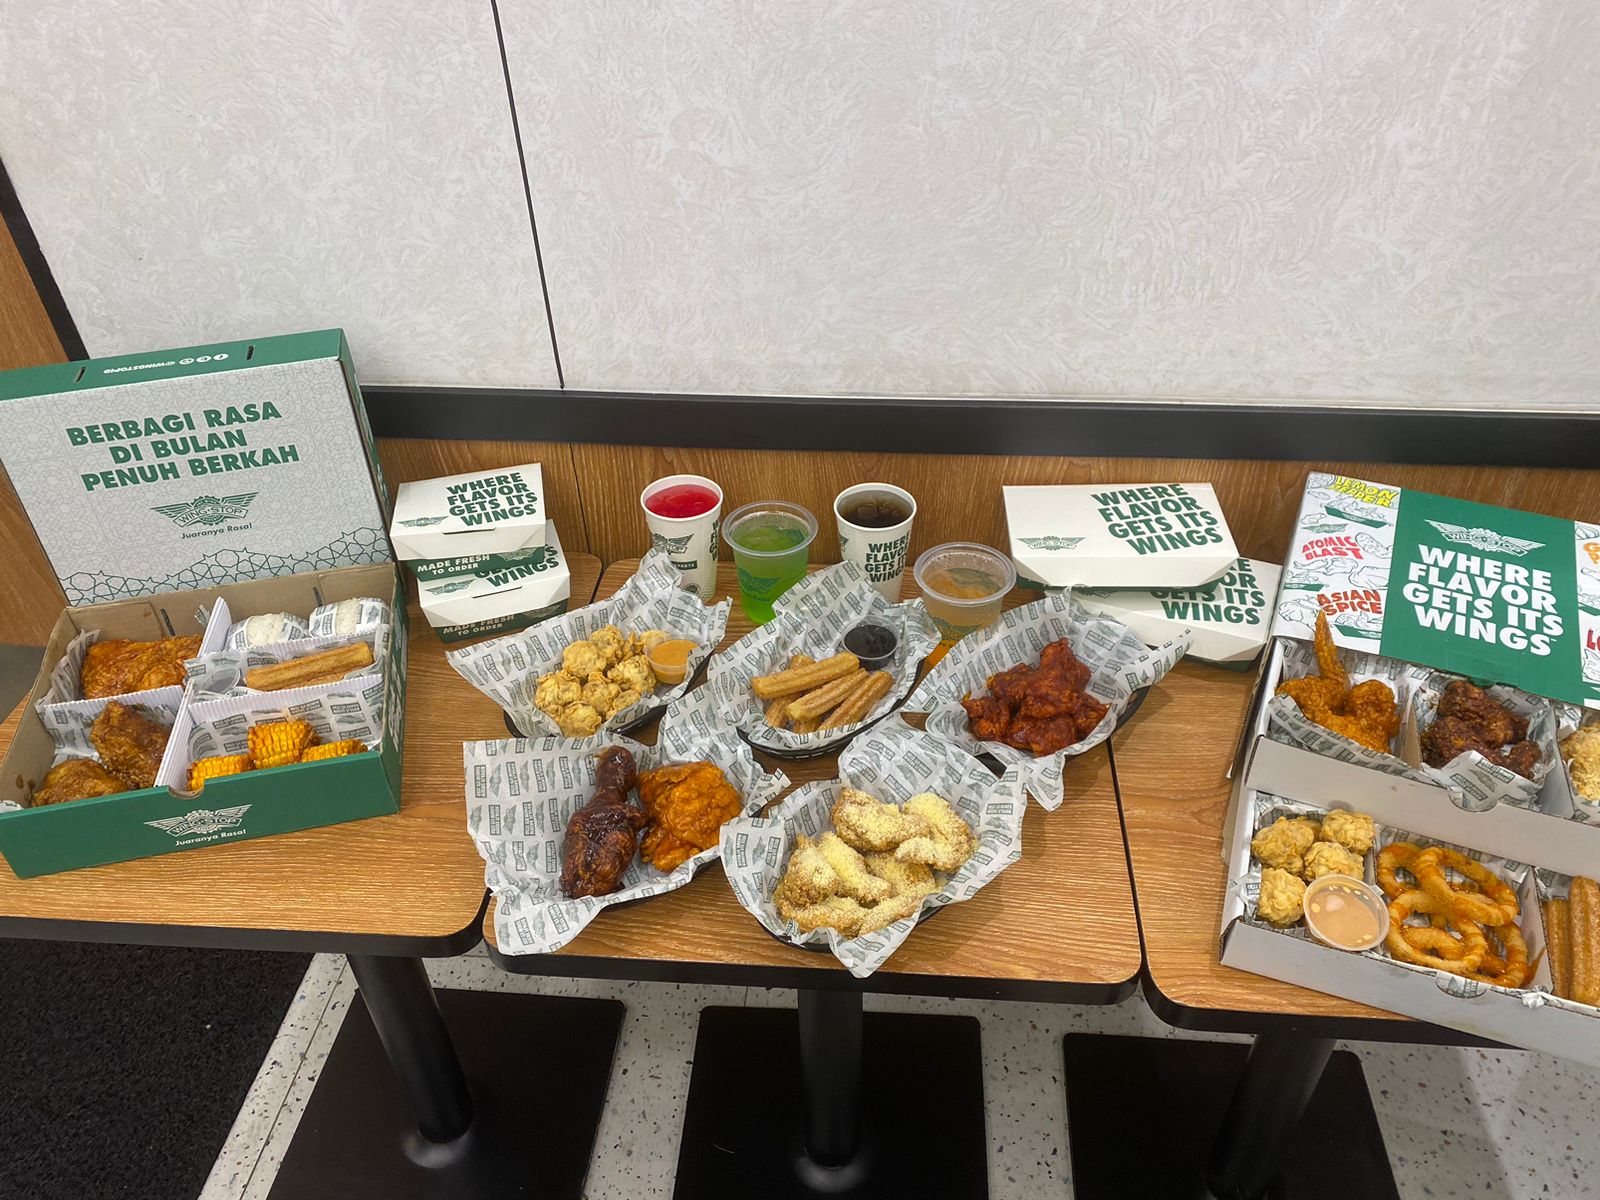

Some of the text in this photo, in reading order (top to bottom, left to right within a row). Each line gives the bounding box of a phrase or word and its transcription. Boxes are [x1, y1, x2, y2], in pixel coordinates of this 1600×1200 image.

[66, 401, 282, 446] BERBAGI RASA
[109, 430, 248, 465] DI BULAN
[81, 445, 300, 492] PENUH BERKAH
[446, 472, 523, 495] WHERE
[447, 483, 530, 506] FLAVOR
[1091, 483, 1189, 507] WHERE
[1336, 475, 1399, 501] LEMON
[449, 491, 538, 517] GETS ITS
[1328, 485, 1392, 508] PEPPER
[460, 504, 537, 527] WINGS
[1098, 496, 1203, 523] FLAVOR
[181, 527, 224, 539] Juaranya
[1107, 510, 1219, 539] GETS ITS
[1126, 527, 1223, 556] WINGS
[1302, 536, 1358, 553] ATOMIC
[417, 561, 451, 573] MADE
[454, 554, 490, 566] FRESH
[1305, 547, 1364, 560] BLAST
[432, 568, 444, 576] TO
[449, 563, 479, 573] ORDER
[486, 557, 560, 588] WINGS
[864, 561, 894, 573] GETS
[869, 567, 903, 583] WING
[1417, 544, 1552, 592] WHERE
[1225, 588, 1265, 607] ITS
[1316, 590, 1381, 607] ASIAN
[1408, 561, 1557, 615] FLAVOR
[1161, 600, 1261, 625] WINGS
[1323, 601, 1383, 616] SPICE
[1403, 582, 1564, 637] GETS ITS
[443, 614, 515, 635] MADE FRESH
[473, 623, 503, 633] ORDER
[1413, 604, 1552, 657] WINGS
[175, 834, 218, 846] Juaranya
